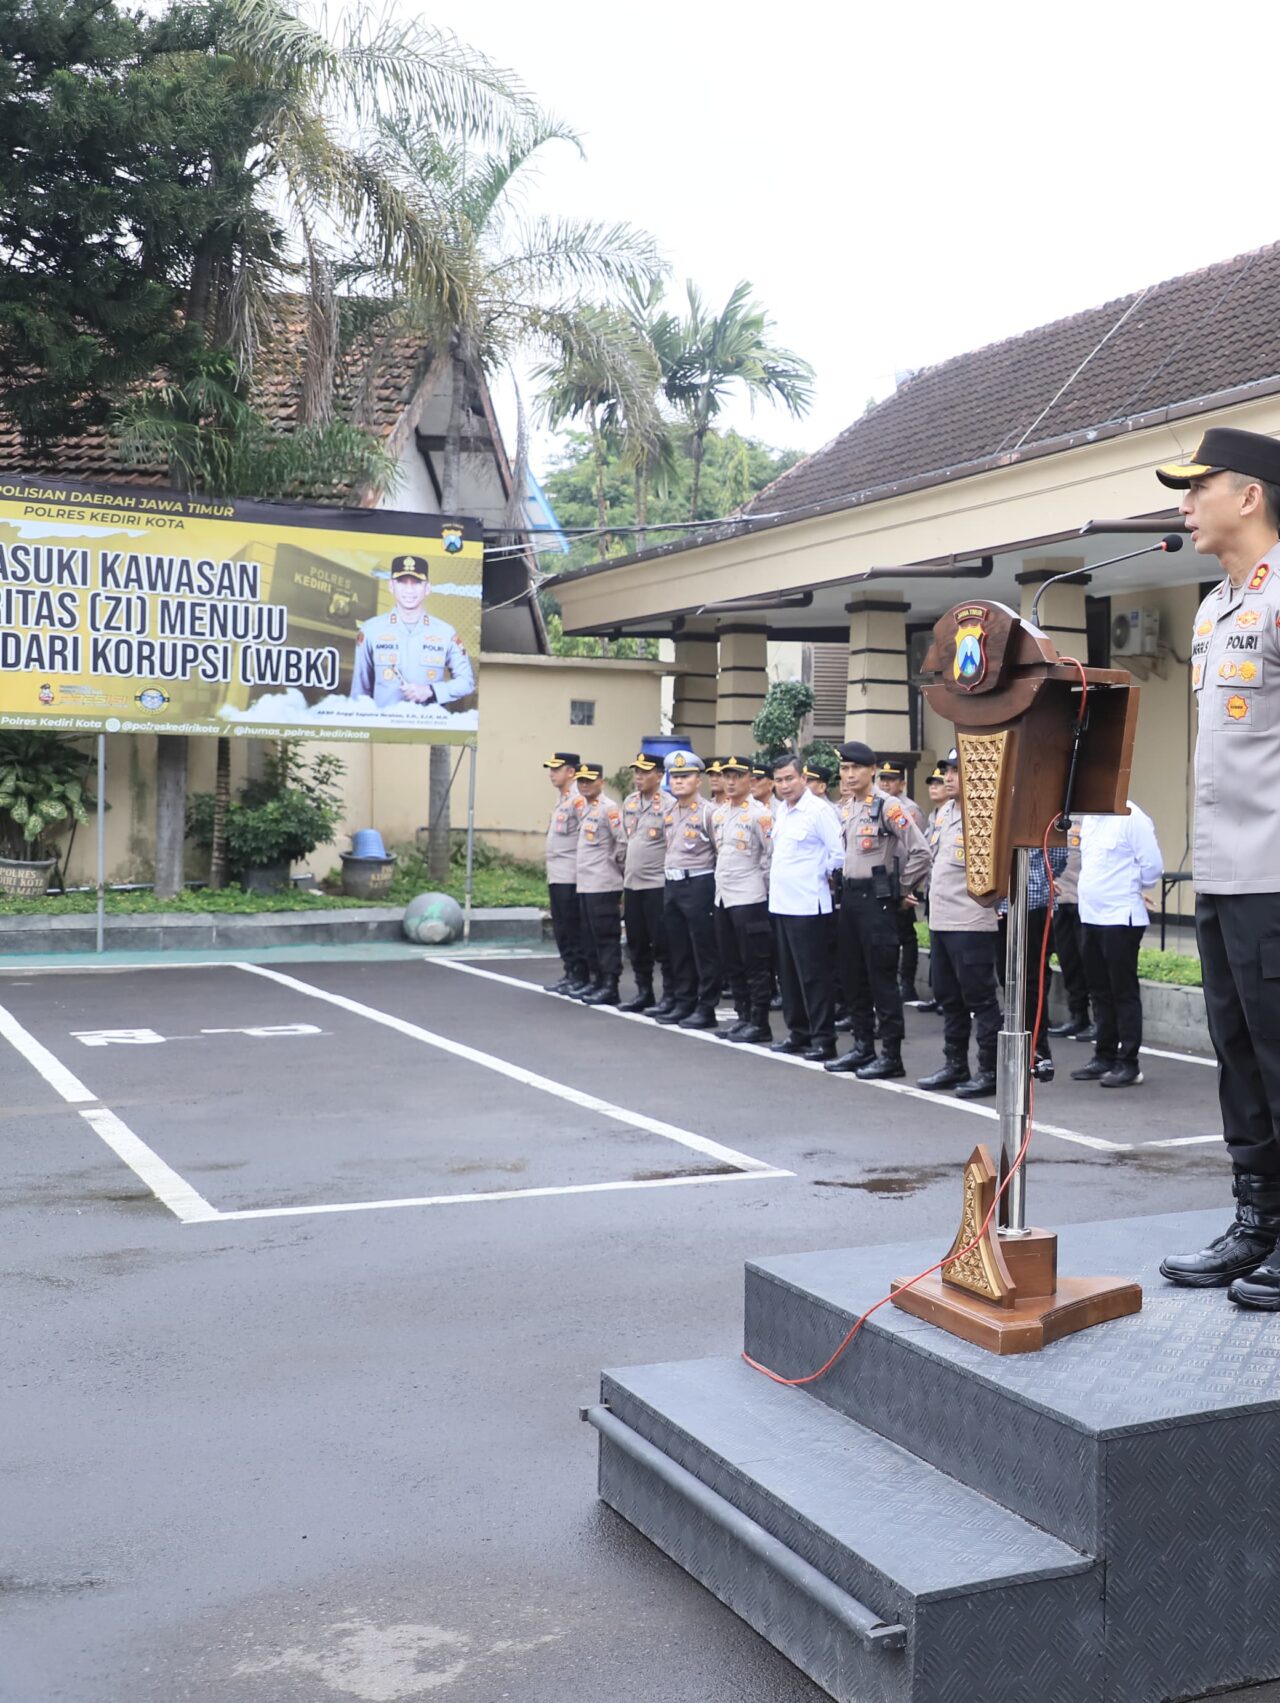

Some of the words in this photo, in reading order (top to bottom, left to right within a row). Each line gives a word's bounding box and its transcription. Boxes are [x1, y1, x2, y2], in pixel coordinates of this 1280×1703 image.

[0, 484, 67, 501] OLISIAN
[70, 491, 136, 507] DAERAH
[139, 498, 184, 513] JAWA
[187, 502, 235, 517] TIMUR
[23, 505, 85, 521] POLRES
[89, 512, 141, 526] KEDIRI
[145, 517, 185, 530] KOTA
[101, 551, 259, 600] KAWASAN
[0, 588, 77, 629] ITAS
[90, 592, 147, 635] (ZI)
[159, 599, 286, 642] MENUJU
[1, 631, 80, 672] DARI
[92, 637, 229, 680] KORUPSI
[241, 644, 337, 687] (WBK)
[1225, 635, 1259, 650] POLRI
[1, 716, 37, 726] Polres
[39, 718, 73, 728] Kediri
[75, 719, 102, 729] Kota
[121, 721, 220, 733] @polreskedirikota
